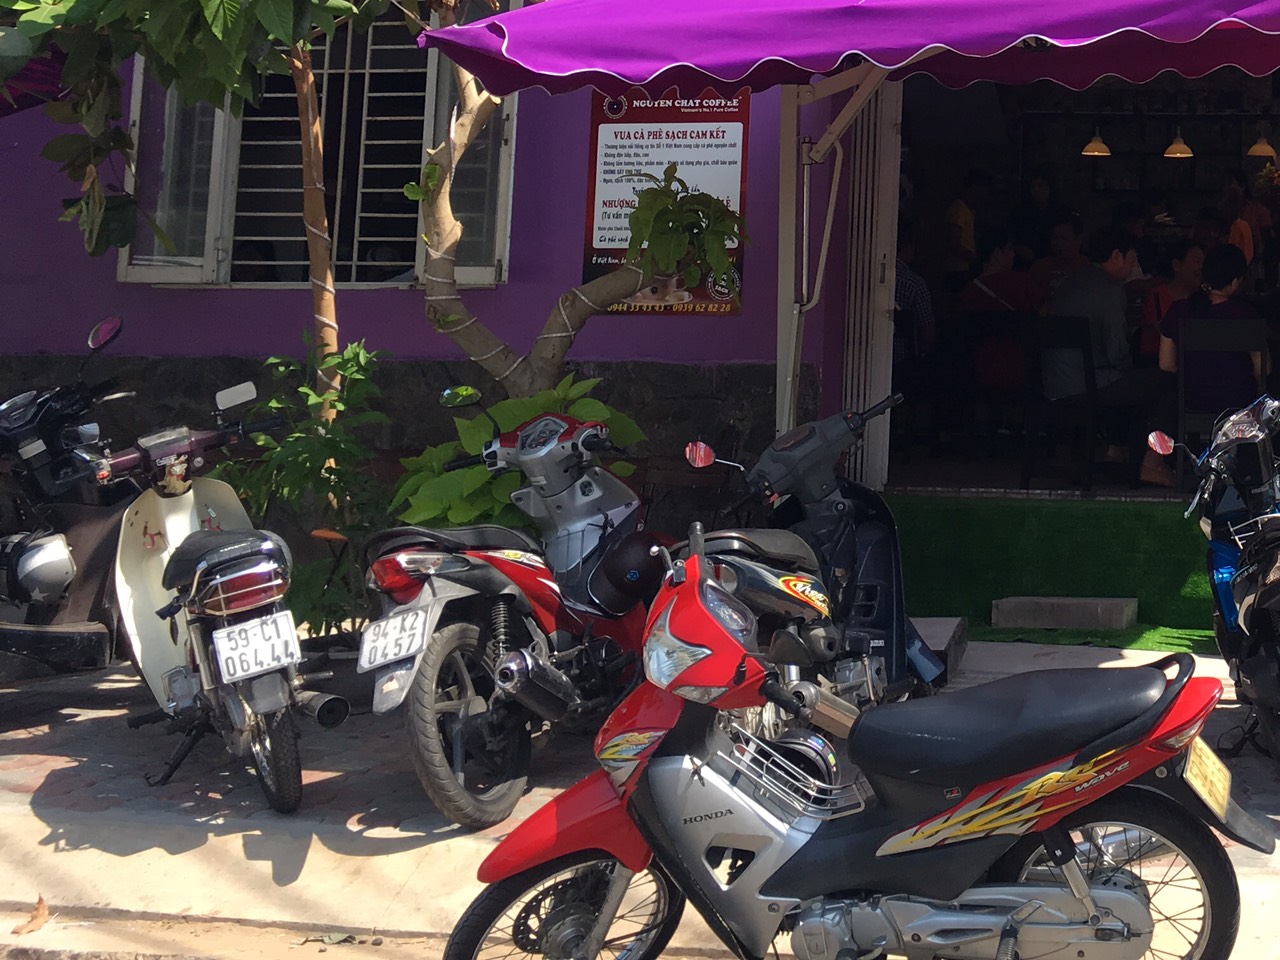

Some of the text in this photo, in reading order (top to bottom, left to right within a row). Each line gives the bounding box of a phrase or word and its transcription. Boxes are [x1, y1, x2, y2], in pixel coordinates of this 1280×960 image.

[632, 98, 740, 108] NGUYEN CHAT COFFEE
[613, 130, 632, 140] VUA
[647, 127, 664, 140] PHÊ
[665, 129, 688, 142] SẠCH
[689, 129, 708, 140] CAM
[368, 632, 417, 665] 0457
[682, 808, 735, 825] HONDA
